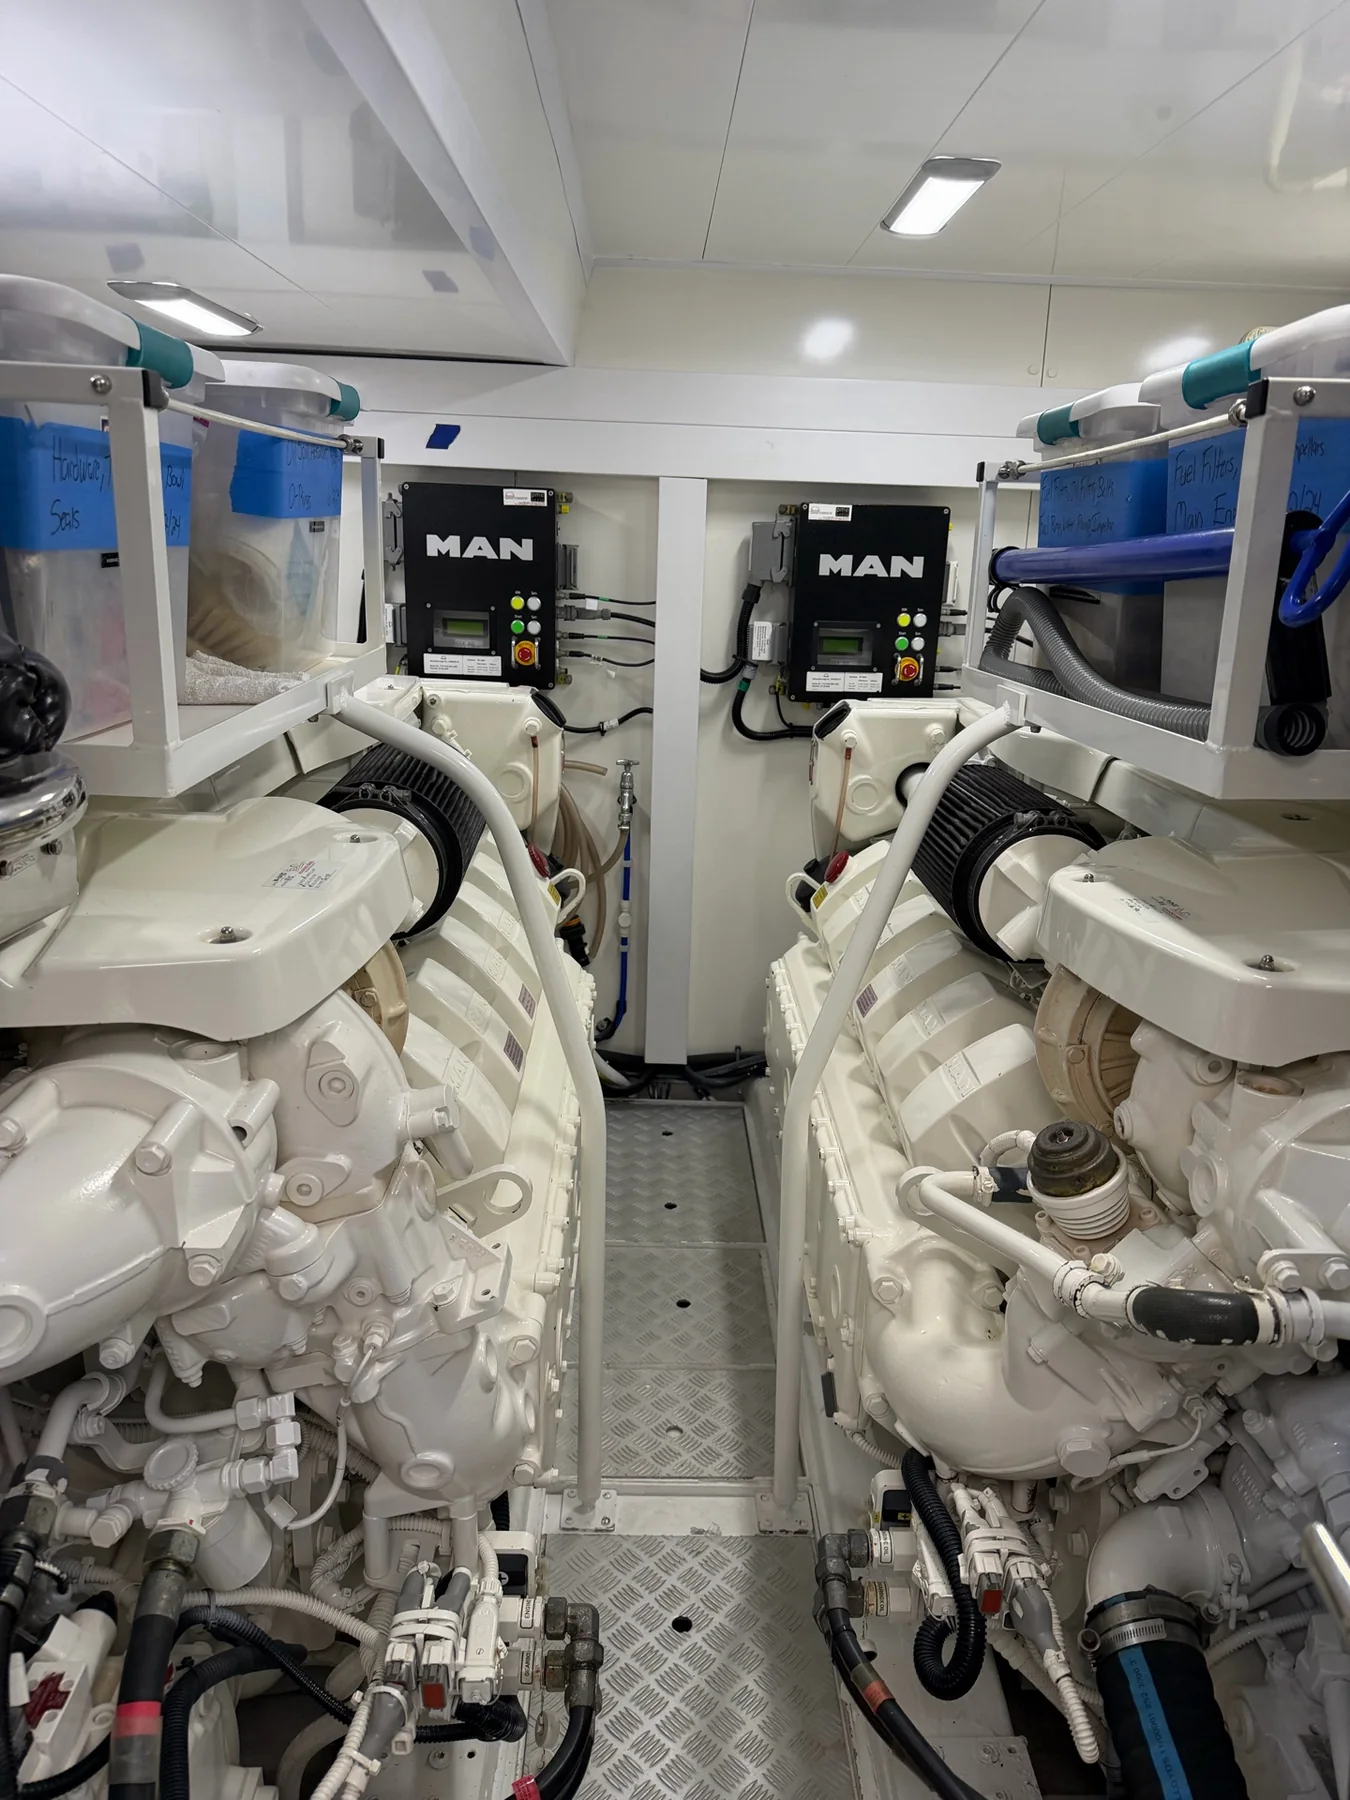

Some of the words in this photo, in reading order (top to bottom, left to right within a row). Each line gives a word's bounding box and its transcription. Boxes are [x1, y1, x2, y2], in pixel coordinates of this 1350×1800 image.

[1174, 449, 1197, 490] Fuel
[1201, 445, 1239, 484] Filters,
[50, 498, 80, 536] Seals
[425, 533, 535, 562] MAN
[818, 553, 926, 579] MAN
